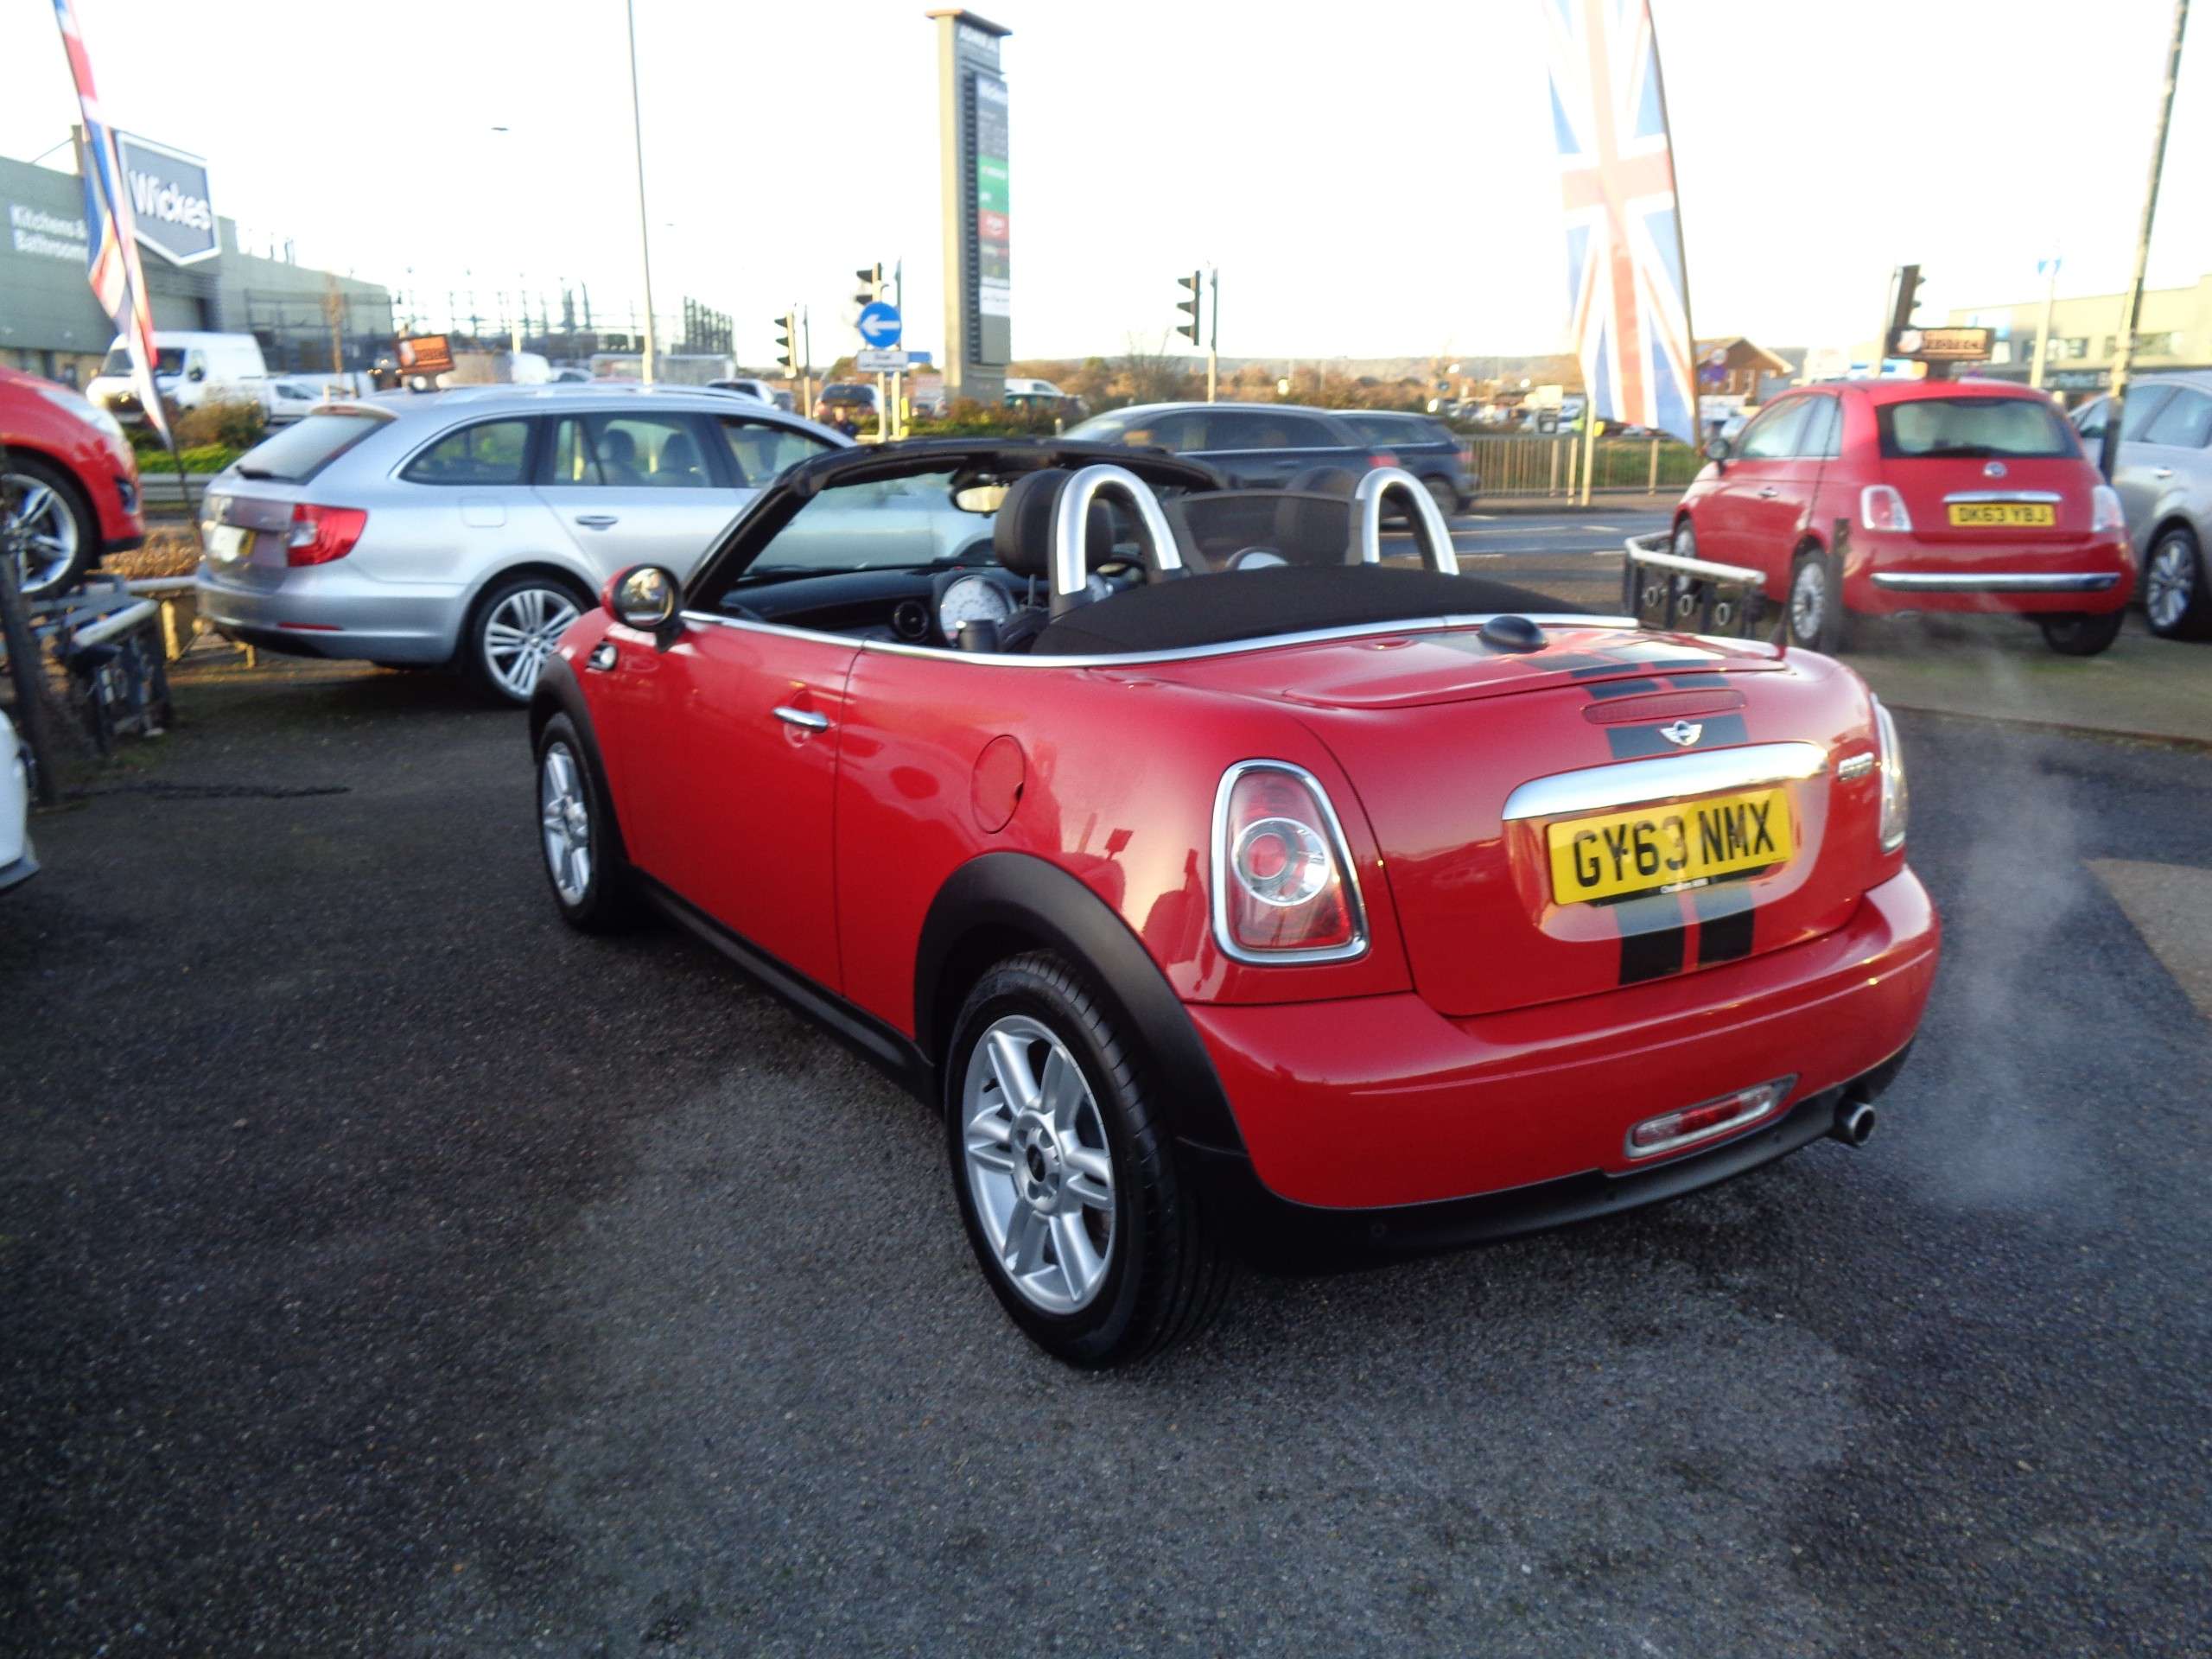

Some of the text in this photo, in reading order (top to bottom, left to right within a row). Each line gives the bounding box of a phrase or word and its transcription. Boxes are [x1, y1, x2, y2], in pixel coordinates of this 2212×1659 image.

[128, 169, 212, 231] Wickes
[1572, 799, 1776, 888] GY63 NMX
